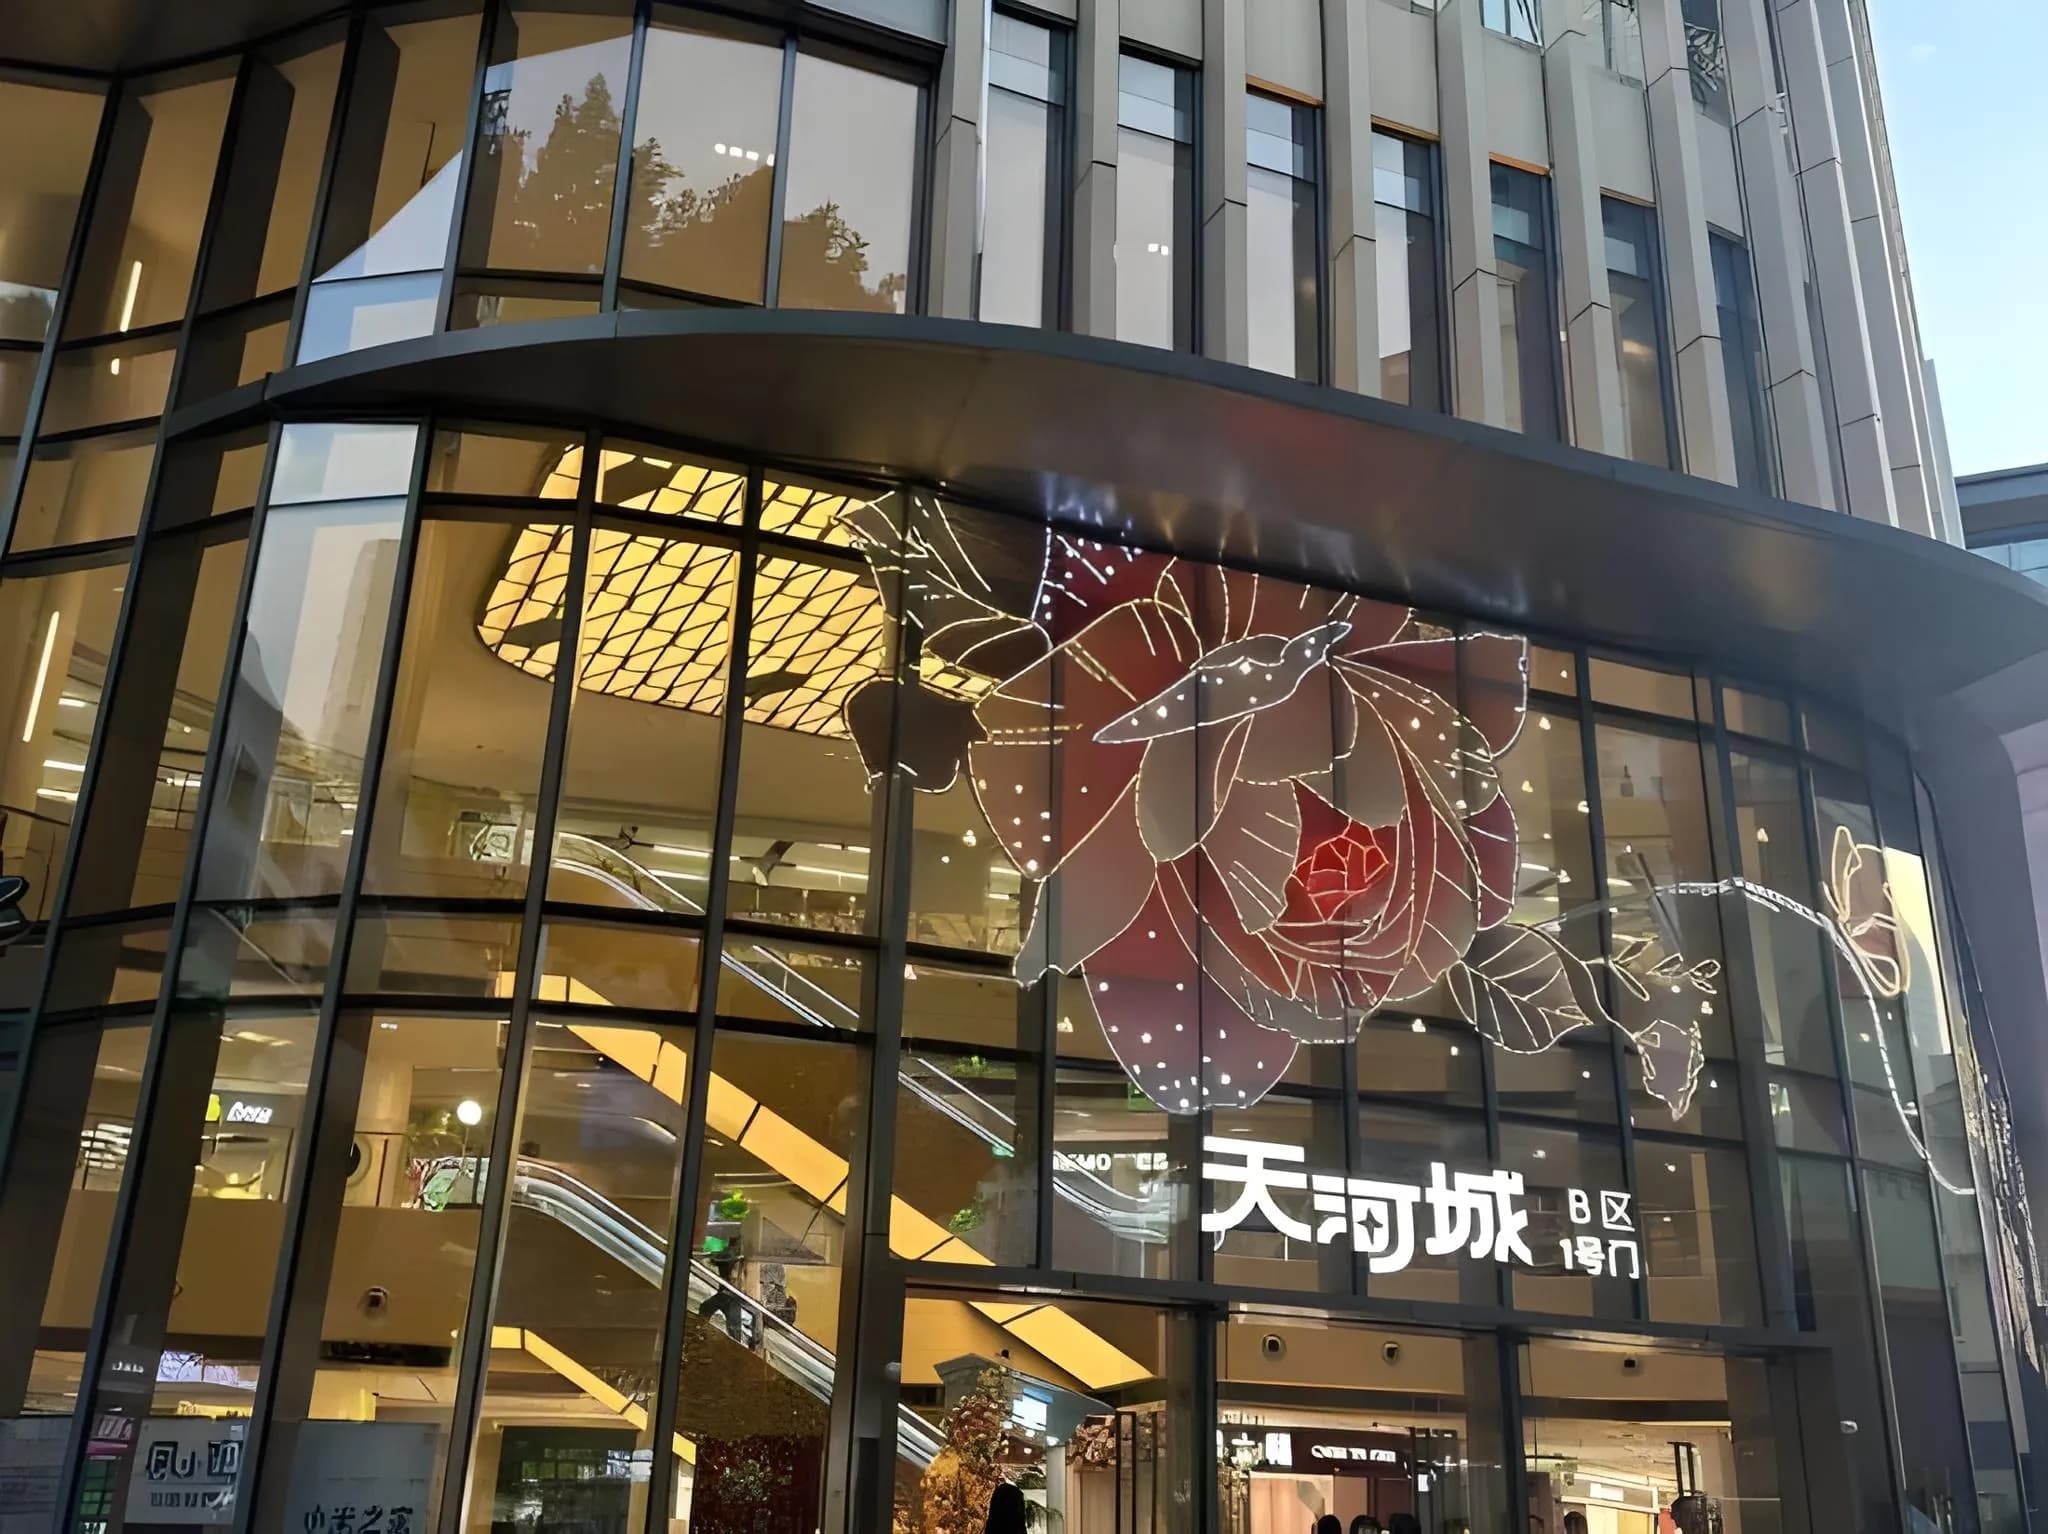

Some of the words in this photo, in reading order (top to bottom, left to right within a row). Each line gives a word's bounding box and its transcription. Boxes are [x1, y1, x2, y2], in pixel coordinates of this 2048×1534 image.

[1201, 1135, 1534, 1274] 天河城
[1567, 1187, 1636, 1233] B区
[1559, 1236, 1640, 1280] 1号门
